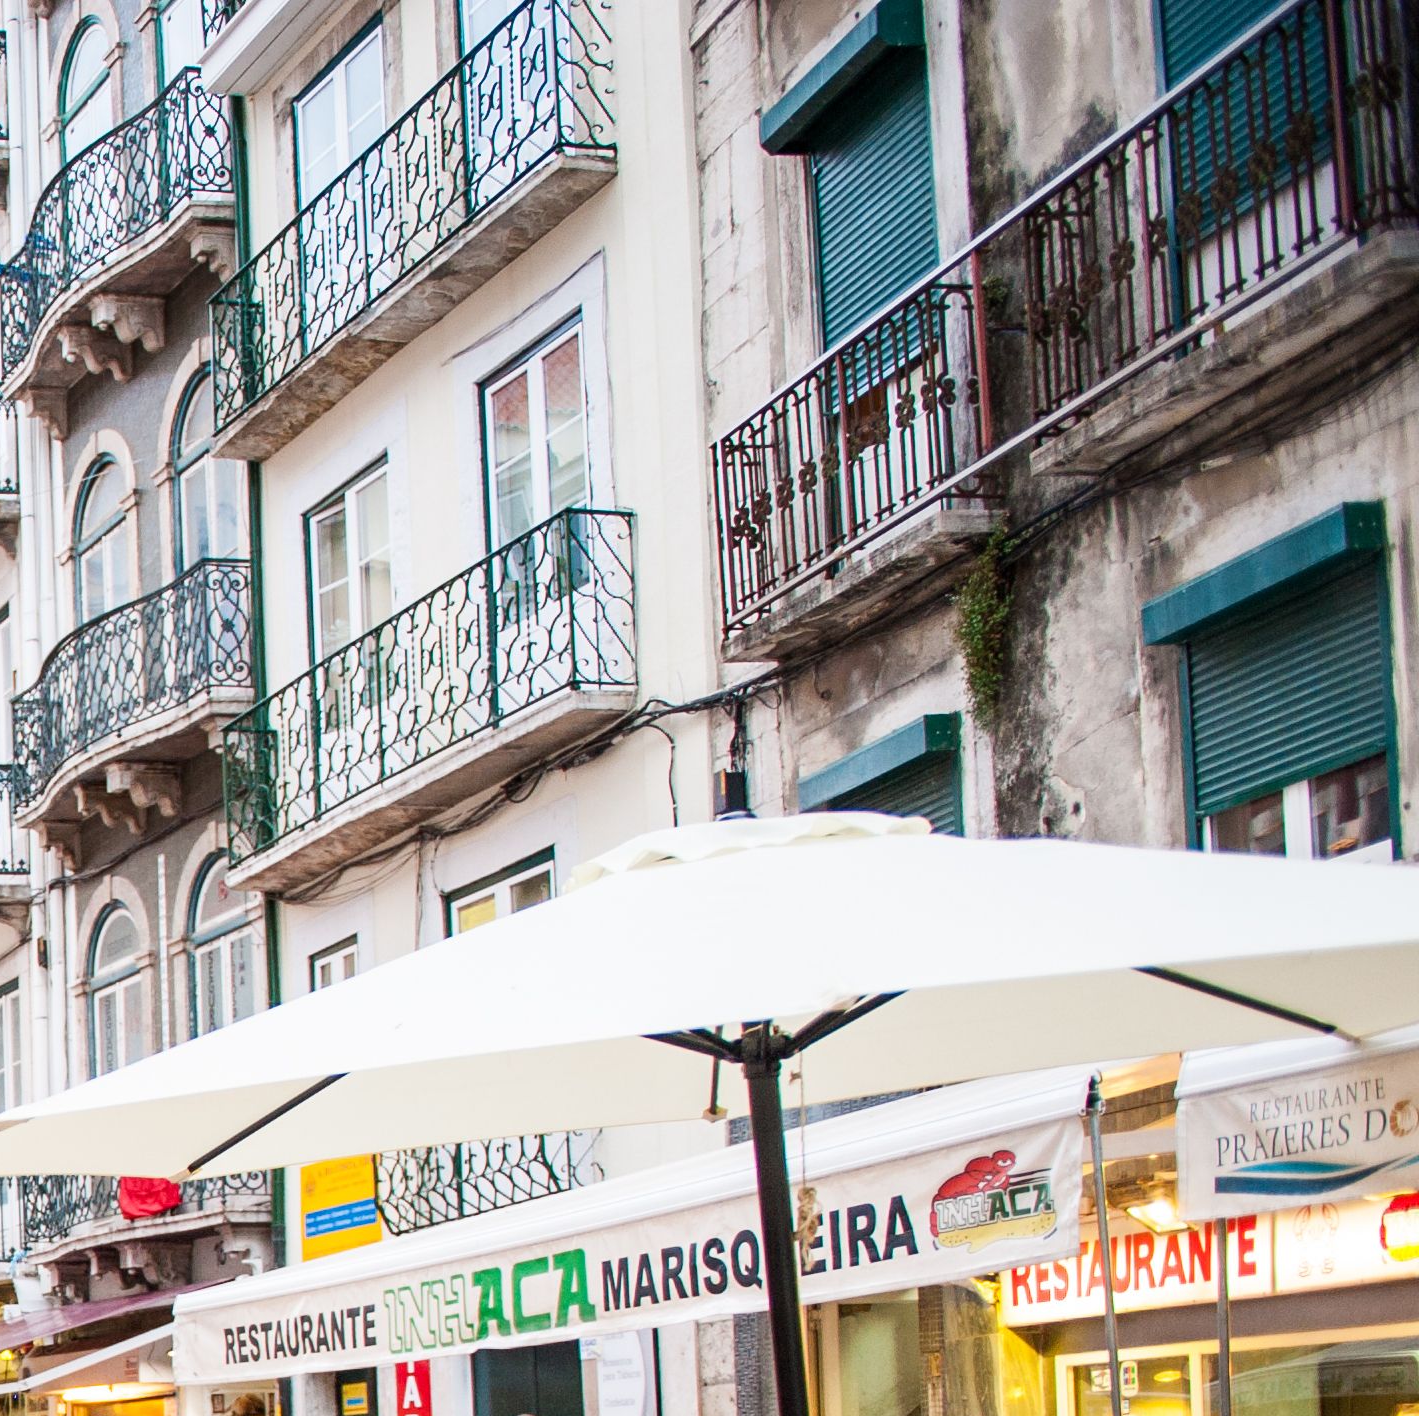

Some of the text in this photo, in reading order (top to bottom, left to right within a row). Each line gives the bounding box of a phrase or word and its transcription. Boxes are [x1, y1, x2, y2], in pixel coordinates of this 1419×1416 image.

[1249, 1077, 1386, 1124] RESTAURANTE
[1216, 1112, 1352, 1168] PRAZERES
[934, 1183, 1055, 1232] INHACA
[223, 1194, 919, 1364] RESTAURANTE INHACA MARISQEIRA
